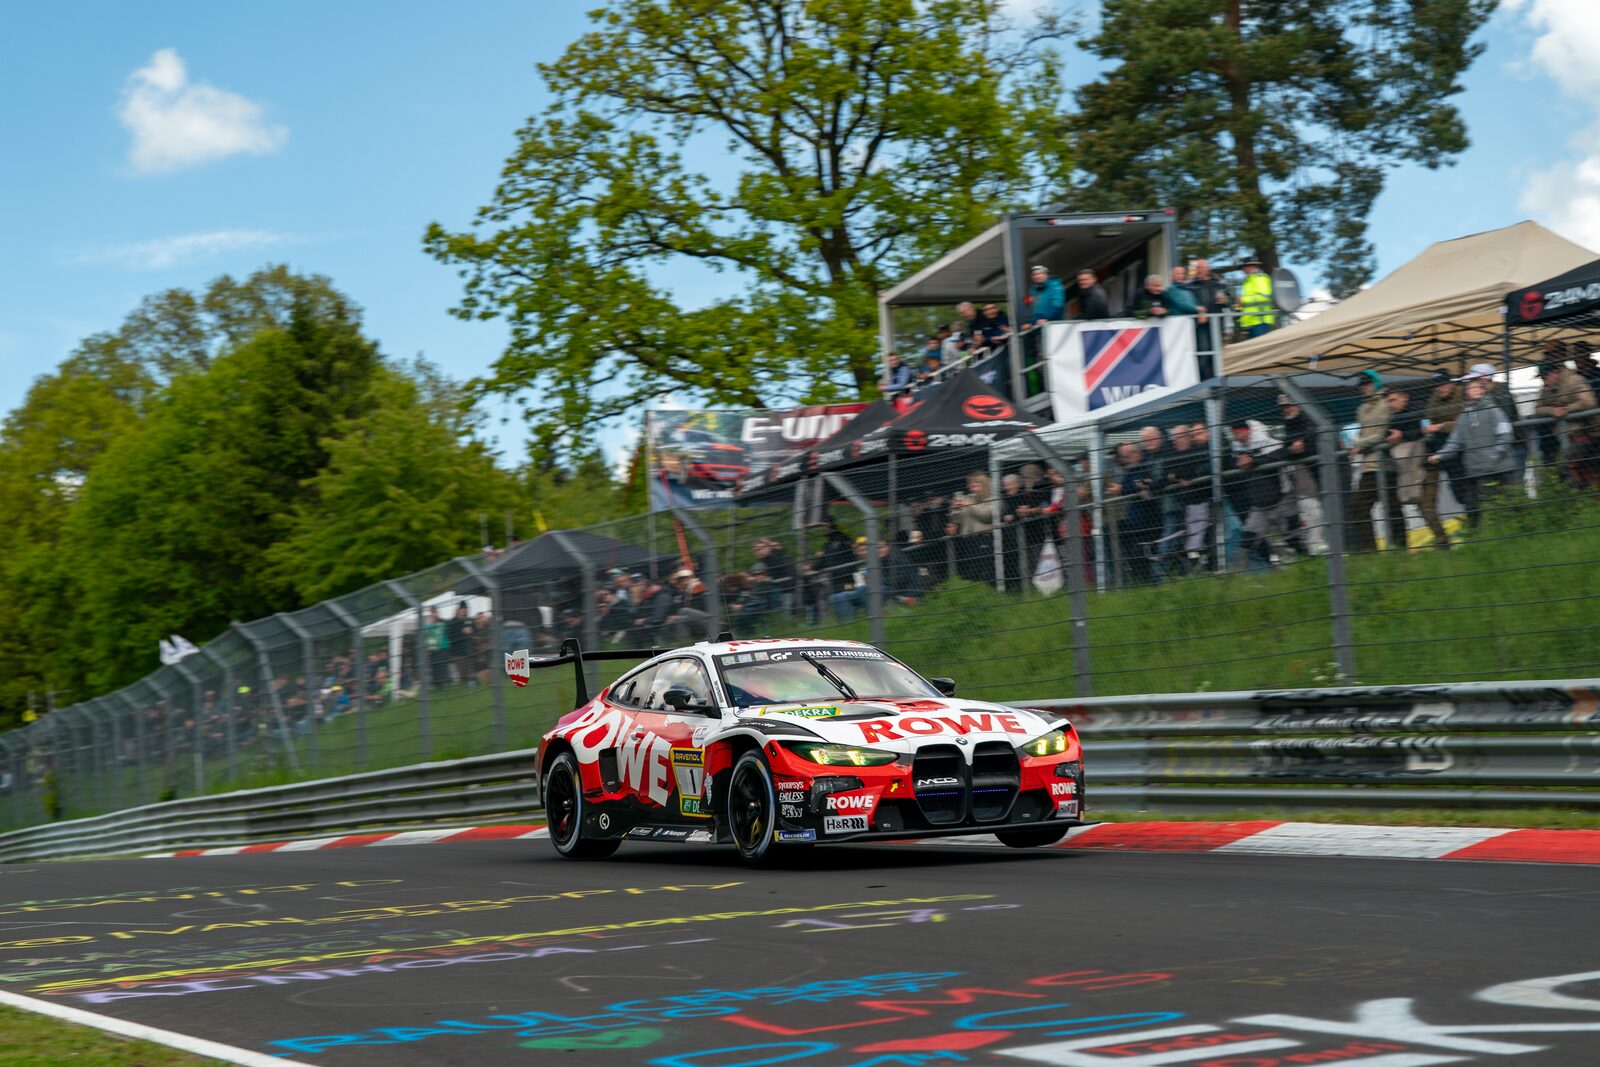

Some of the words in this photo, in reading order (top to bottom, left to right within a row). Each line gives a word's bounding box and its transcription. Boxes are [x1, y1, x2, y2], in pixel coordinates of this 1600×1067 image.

[1101, 384, 1162, 407] WI
[507, 656, 526, 671] ROWE
[855, 713, 1028, 744] ROWE
[543, 700, 673, 807] ROWE
[675, 752, 701, 761] RAVENOL
[689, 768, 697, 794] 1
[1051, 782, 1077, 795] ROWE
[778, 791, 804, 801] ENDLESS
[826, 795, 874, 810] ROWE
[827, 818, 850, 829] H&R
